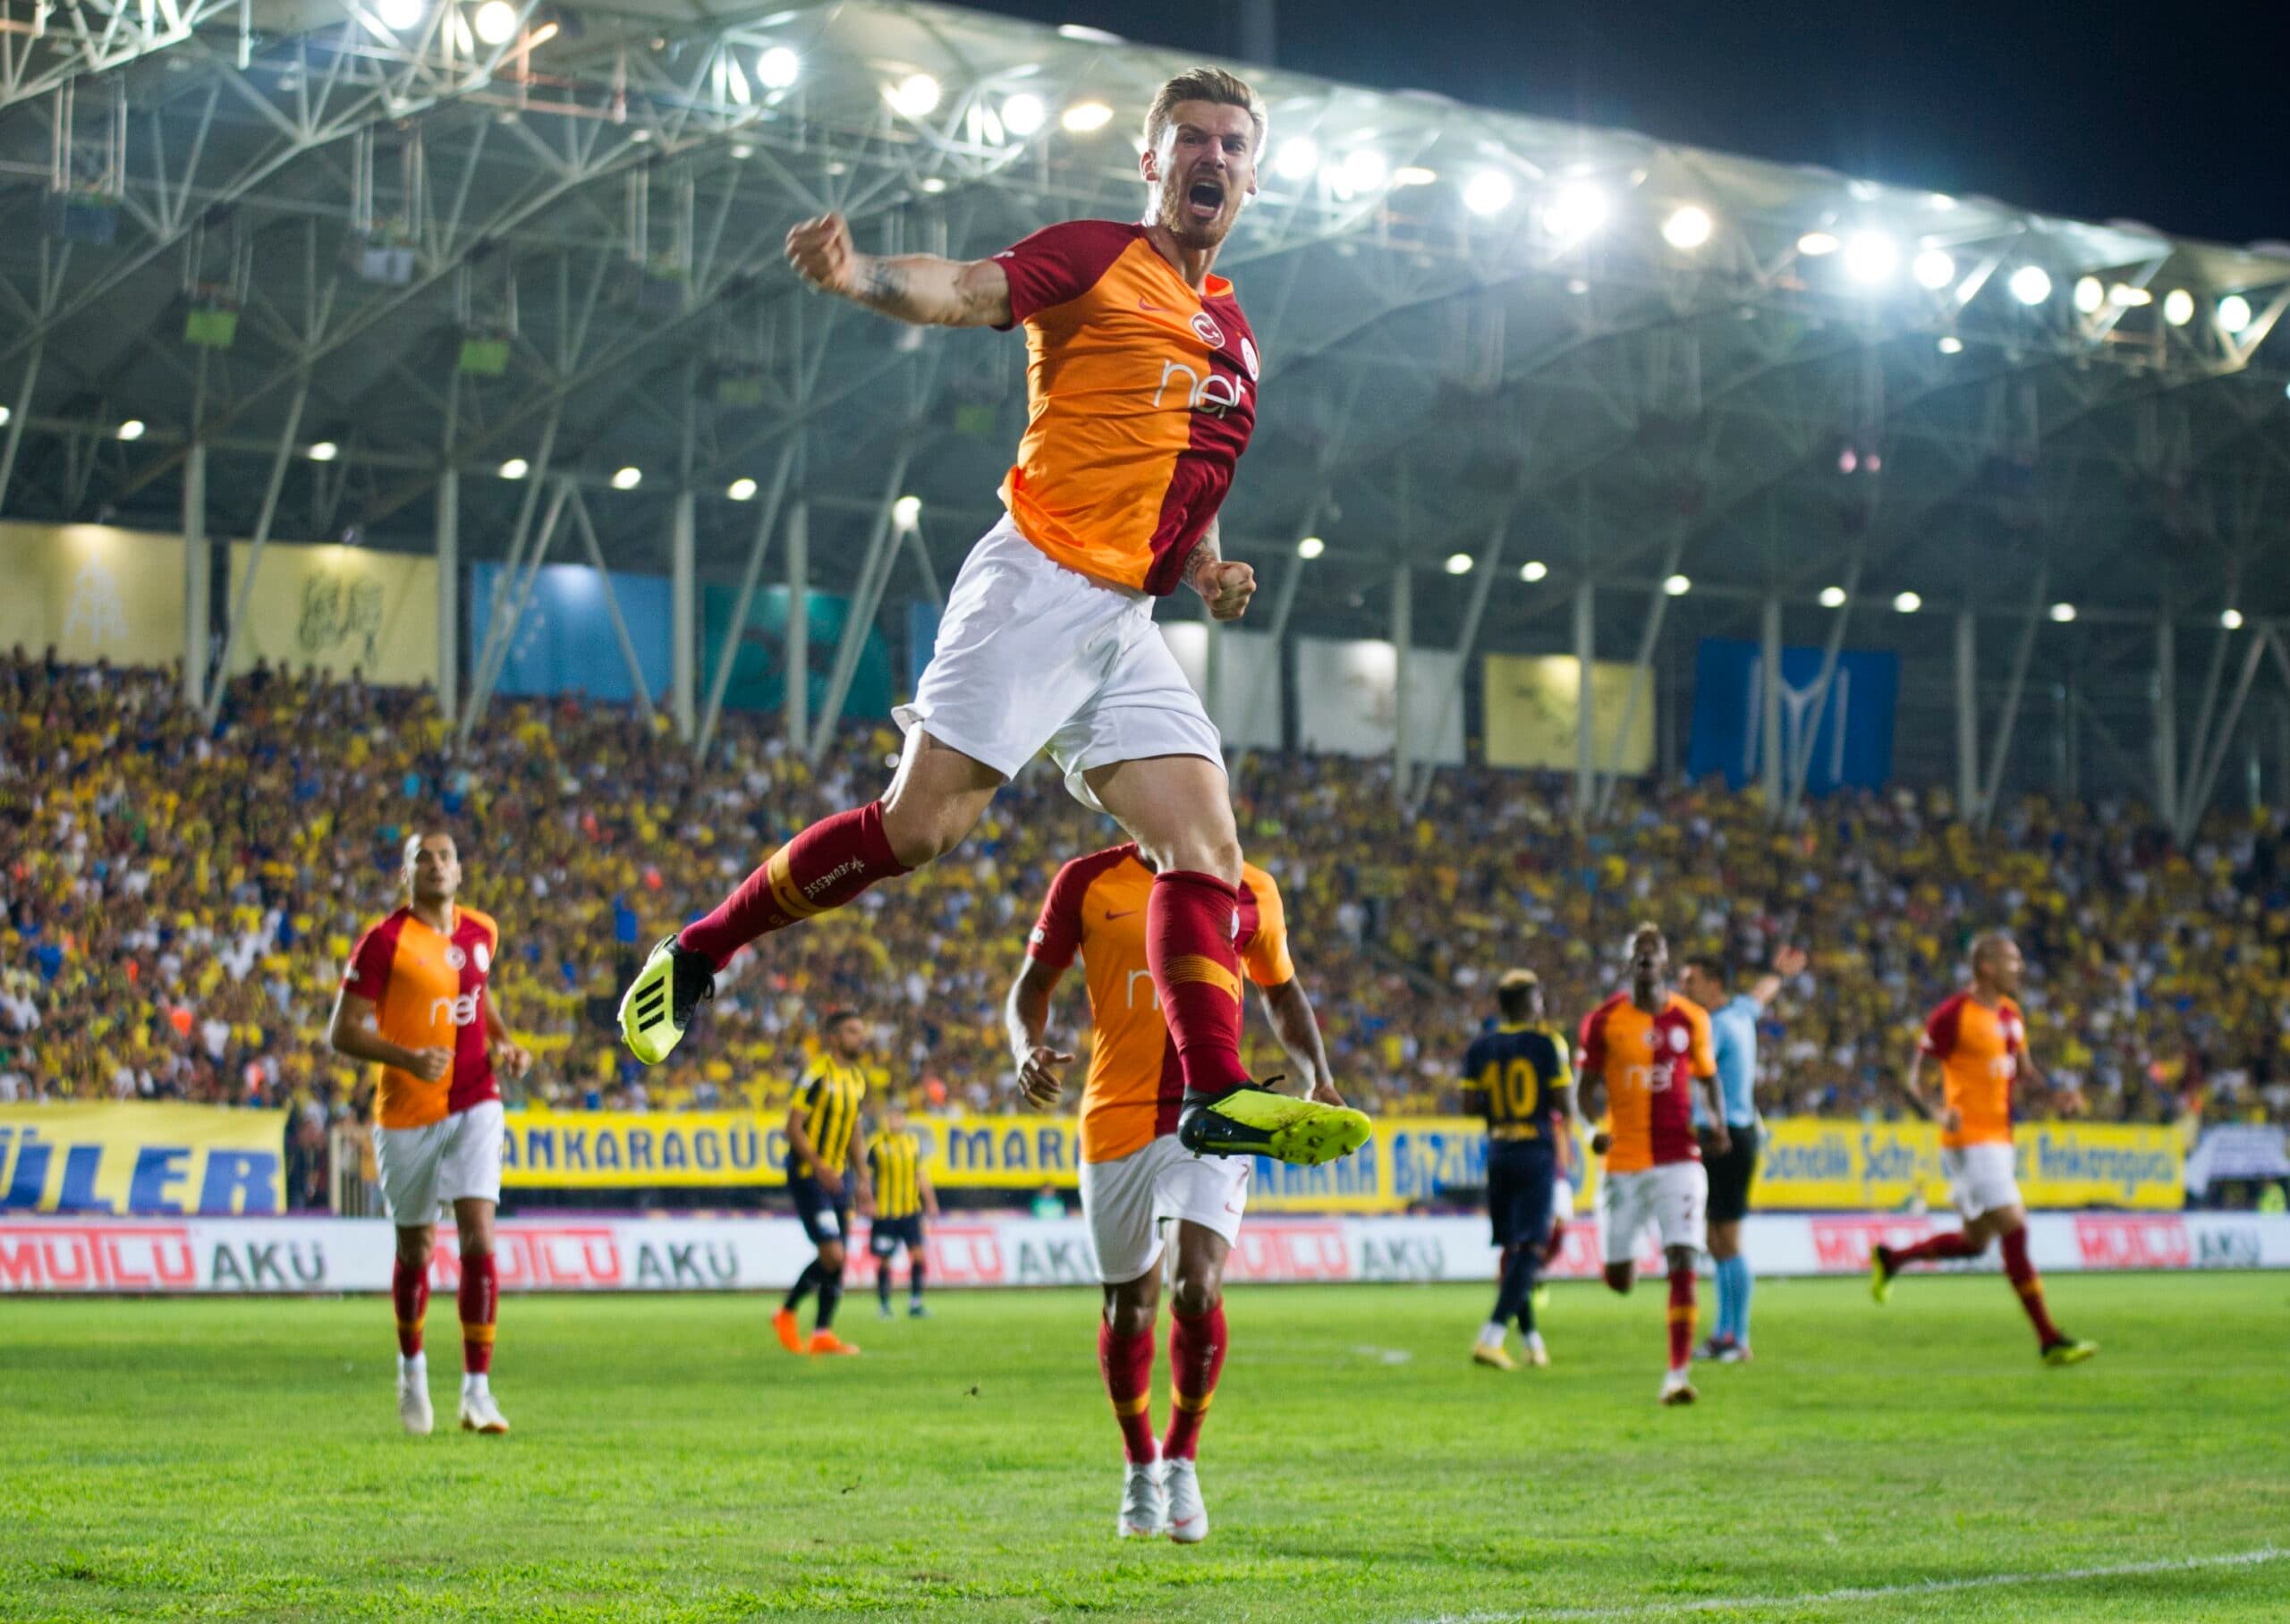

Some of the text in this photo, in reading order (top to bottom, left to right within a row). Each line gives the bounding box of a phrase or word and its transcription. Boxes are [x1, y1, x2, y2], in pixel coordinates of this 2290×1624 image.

[803, 861, 850, 901] JEUNESSE
[429, 984, 482, 1026] nef
[1480, 1057, 1539, 1118] 10
[0, 1227, 196, 1286] MUTLU
